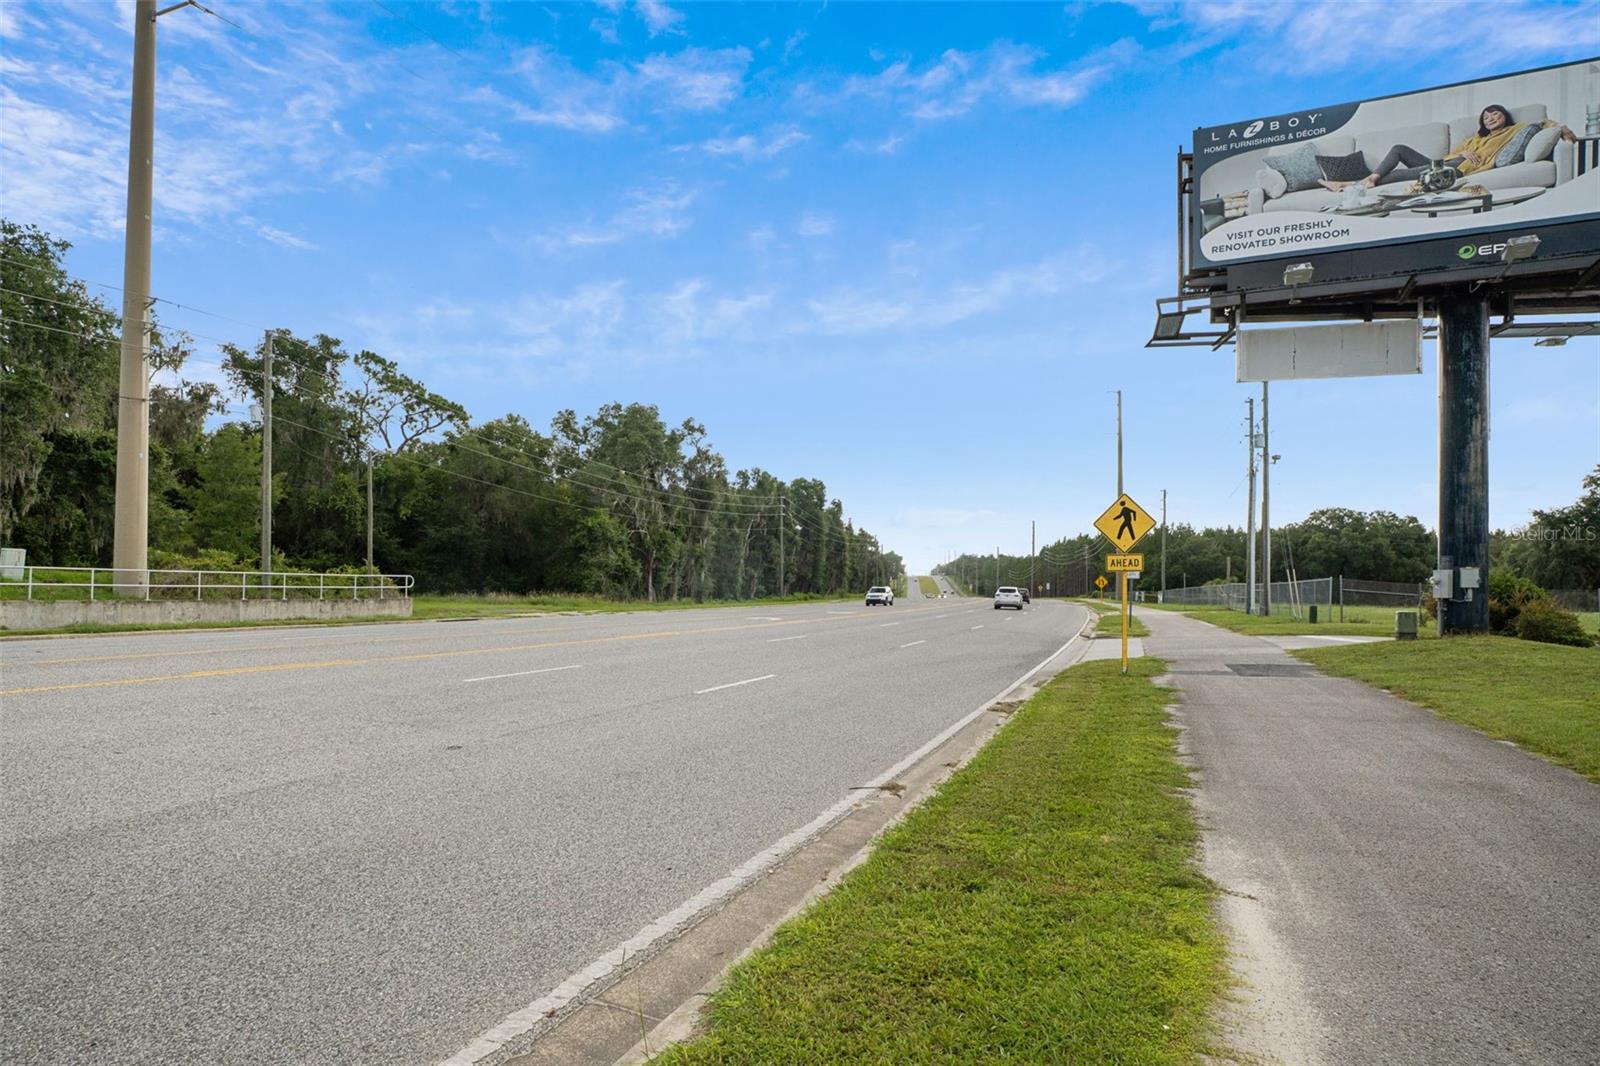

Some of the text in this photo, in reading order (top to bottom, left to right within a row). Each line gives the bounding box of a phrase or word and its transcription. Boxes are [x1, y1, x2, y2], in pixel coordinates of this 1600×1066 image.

[1204, 144, 1228, 154] HOME
[1230, 135, 1286, 150] FURNISHINGS
[1227, 219, 1333, 240] VISIT OUR FRESHLY
[1211, 229, 1350, 254] RENOVATED SHOWROOM
[1110, 559, 1140, 568] AHEAD
